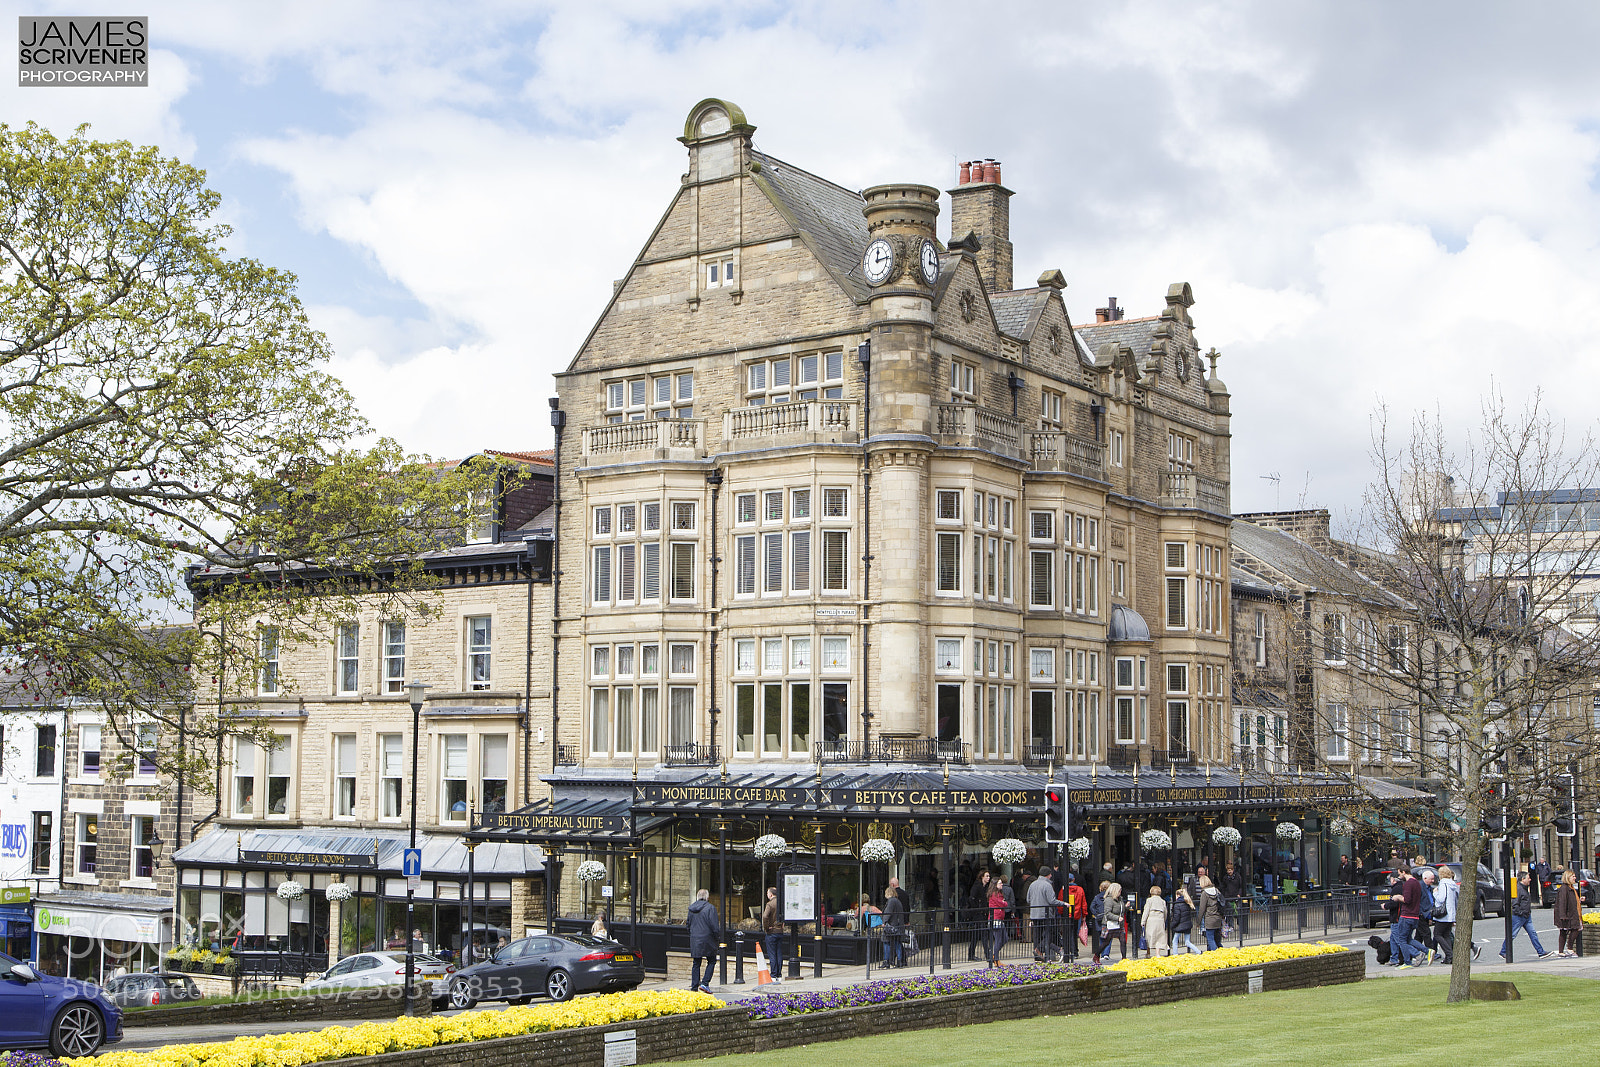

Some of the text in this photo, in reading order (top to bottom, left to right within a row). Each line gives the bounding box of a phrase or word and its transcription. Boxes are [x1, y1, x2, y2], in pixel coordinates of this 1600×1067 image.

[661, 786, 787, 802] MONTPELLIER CAFE BAR
[855, 790, 1027, 805] BETTYS CAFE TEA ROOMS
[1070, 789, 1121, 803] COFFEE ROASTERS
[1156, 789, 1166, 800] TEA
[1168, 788, 1197, 800] MERCHANTS
[1205, 788, 1227, 799] BLENDERS
[498, 815, 604, 830] BETTYS IMPERIAL SUITE
[1, 824, 27, 858] BLUES
[266, 852, 345, 864] BETTYS CAFE TEA ROOMS
[51, 915, 70, 926] OXFAM
